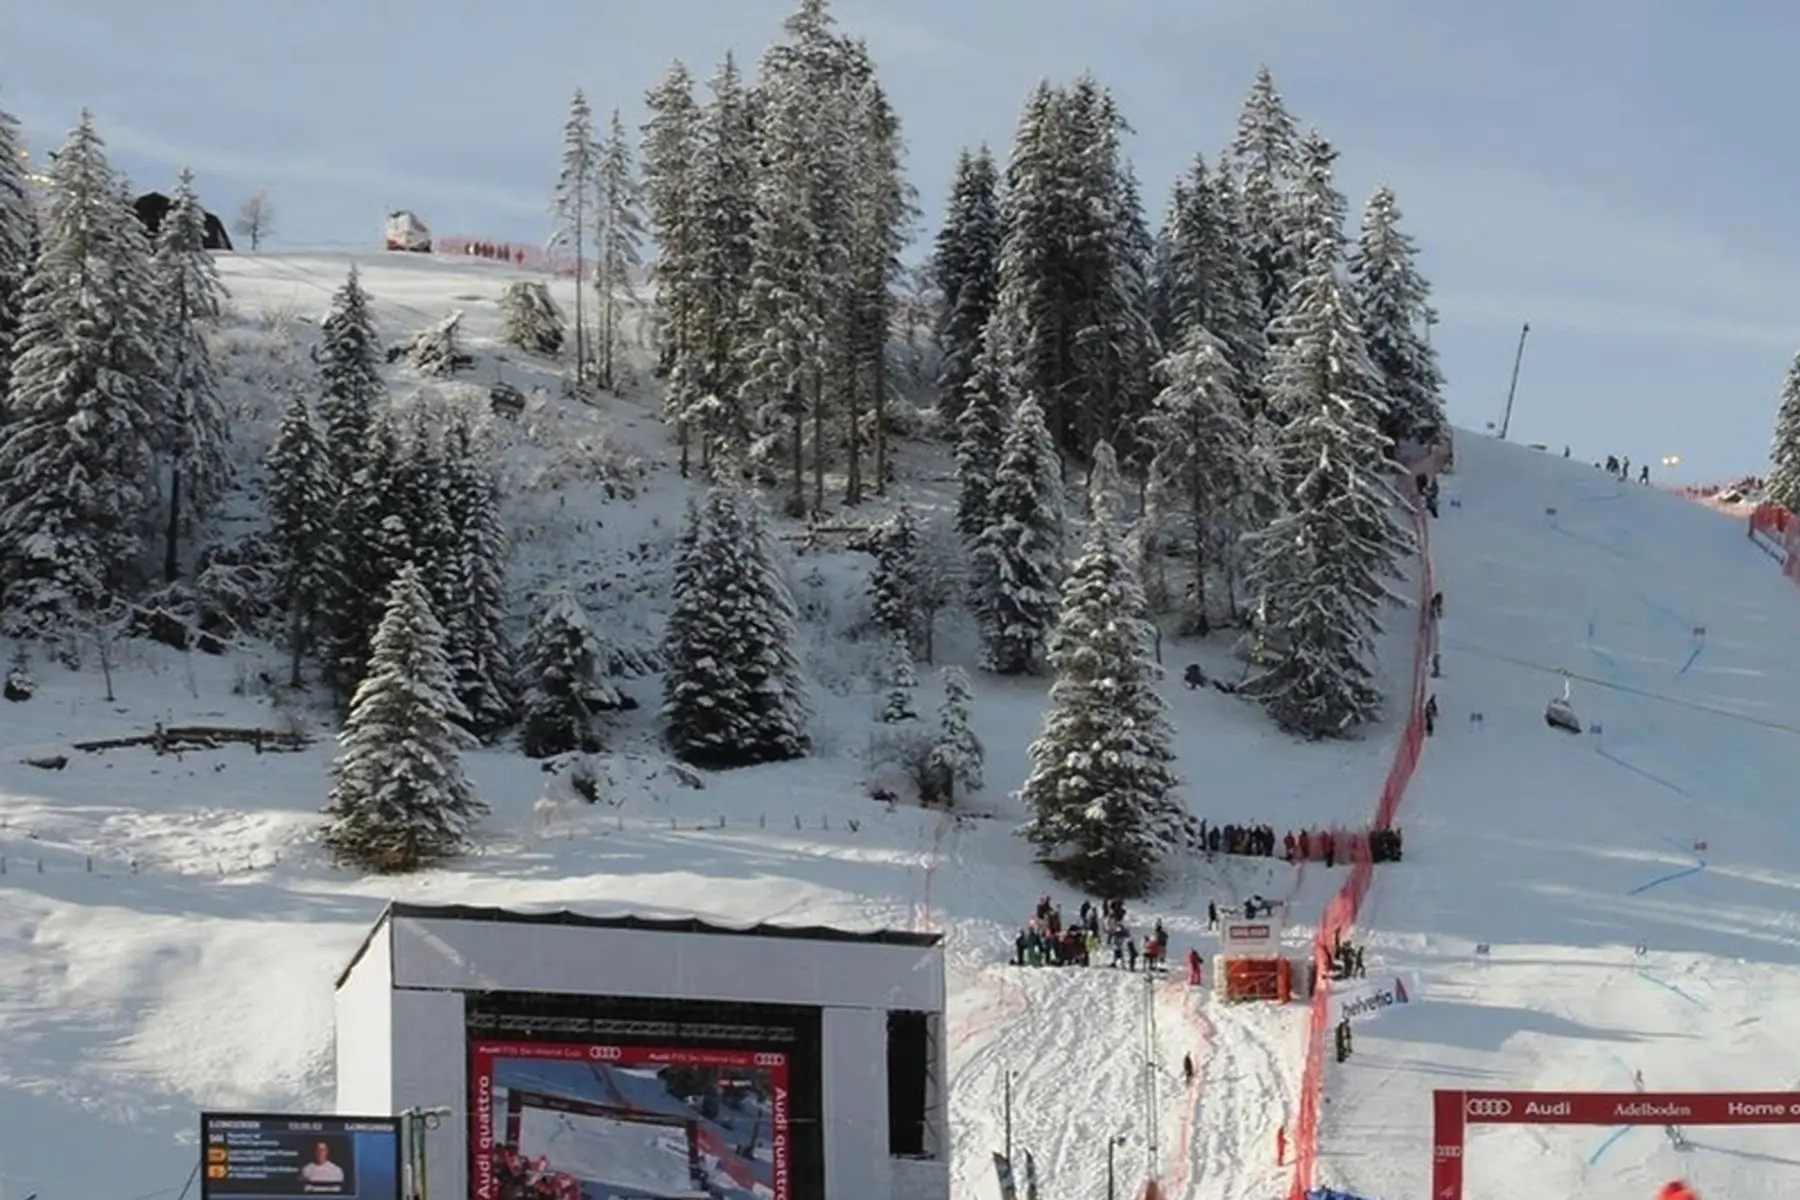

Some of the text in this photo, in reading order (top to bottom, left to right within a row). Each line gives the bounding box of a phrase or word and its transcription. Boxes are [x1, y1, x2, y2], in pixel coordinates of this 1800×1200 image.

[774, 1087, 787, 1131] Audi
[1524, 1101, 1571, 1116] Audi
[1614, 1102, 1691, 1117] Adelboden
[1728, 1102, 1785, 1116] Home
[478, 1075, 492, 1199] Audi quattro
